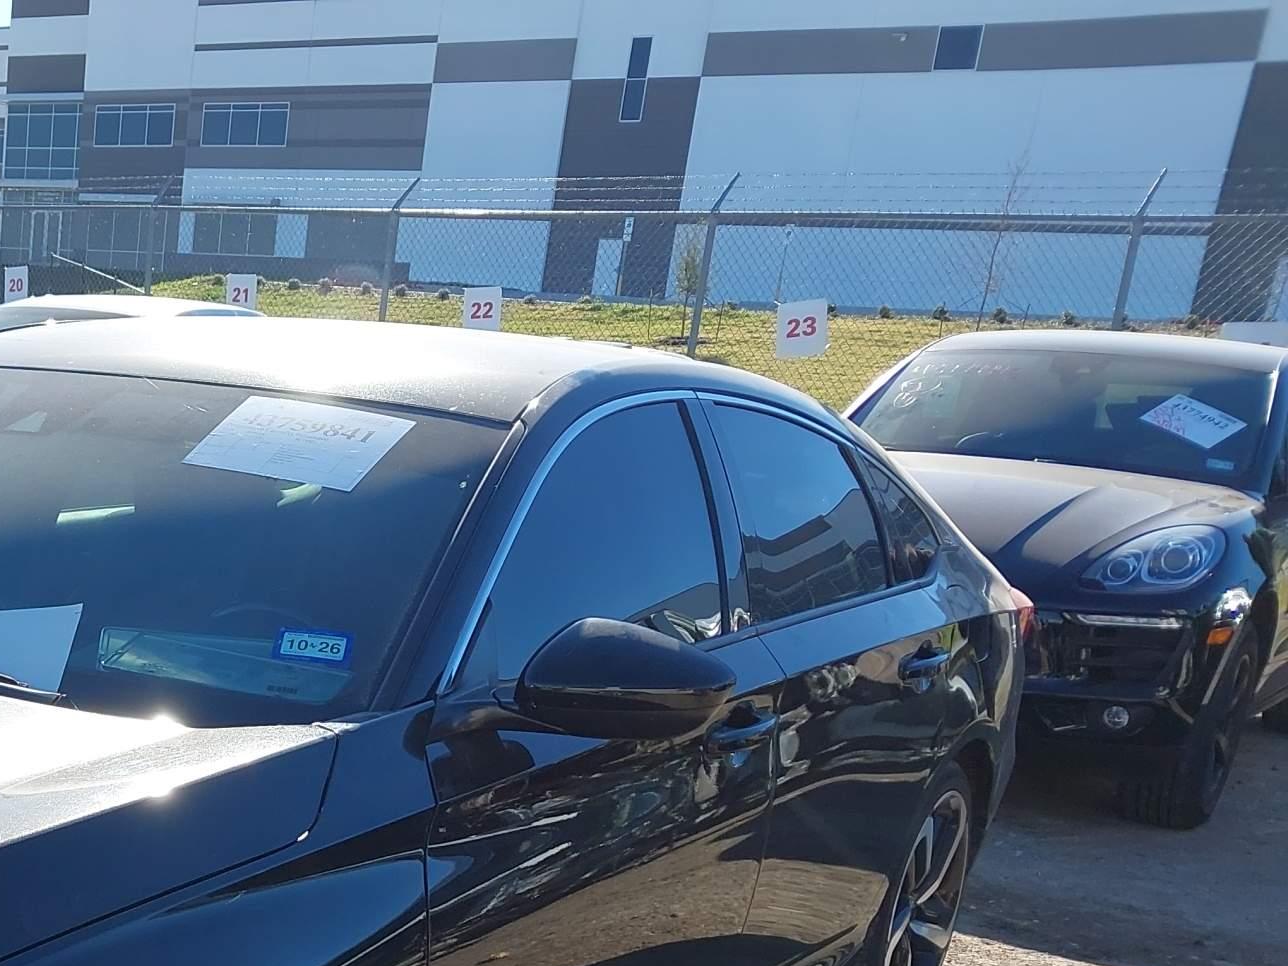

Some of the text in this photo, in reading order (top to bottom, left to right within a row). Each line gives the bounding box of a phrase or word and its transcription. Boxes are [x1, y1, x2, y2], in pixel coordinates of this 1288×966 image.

[9, 278, 23, 292] 20
[231, 287, 249, 303] 21
[470, 302, 493, 319] 22
[786, 316, 817, 338] 23
